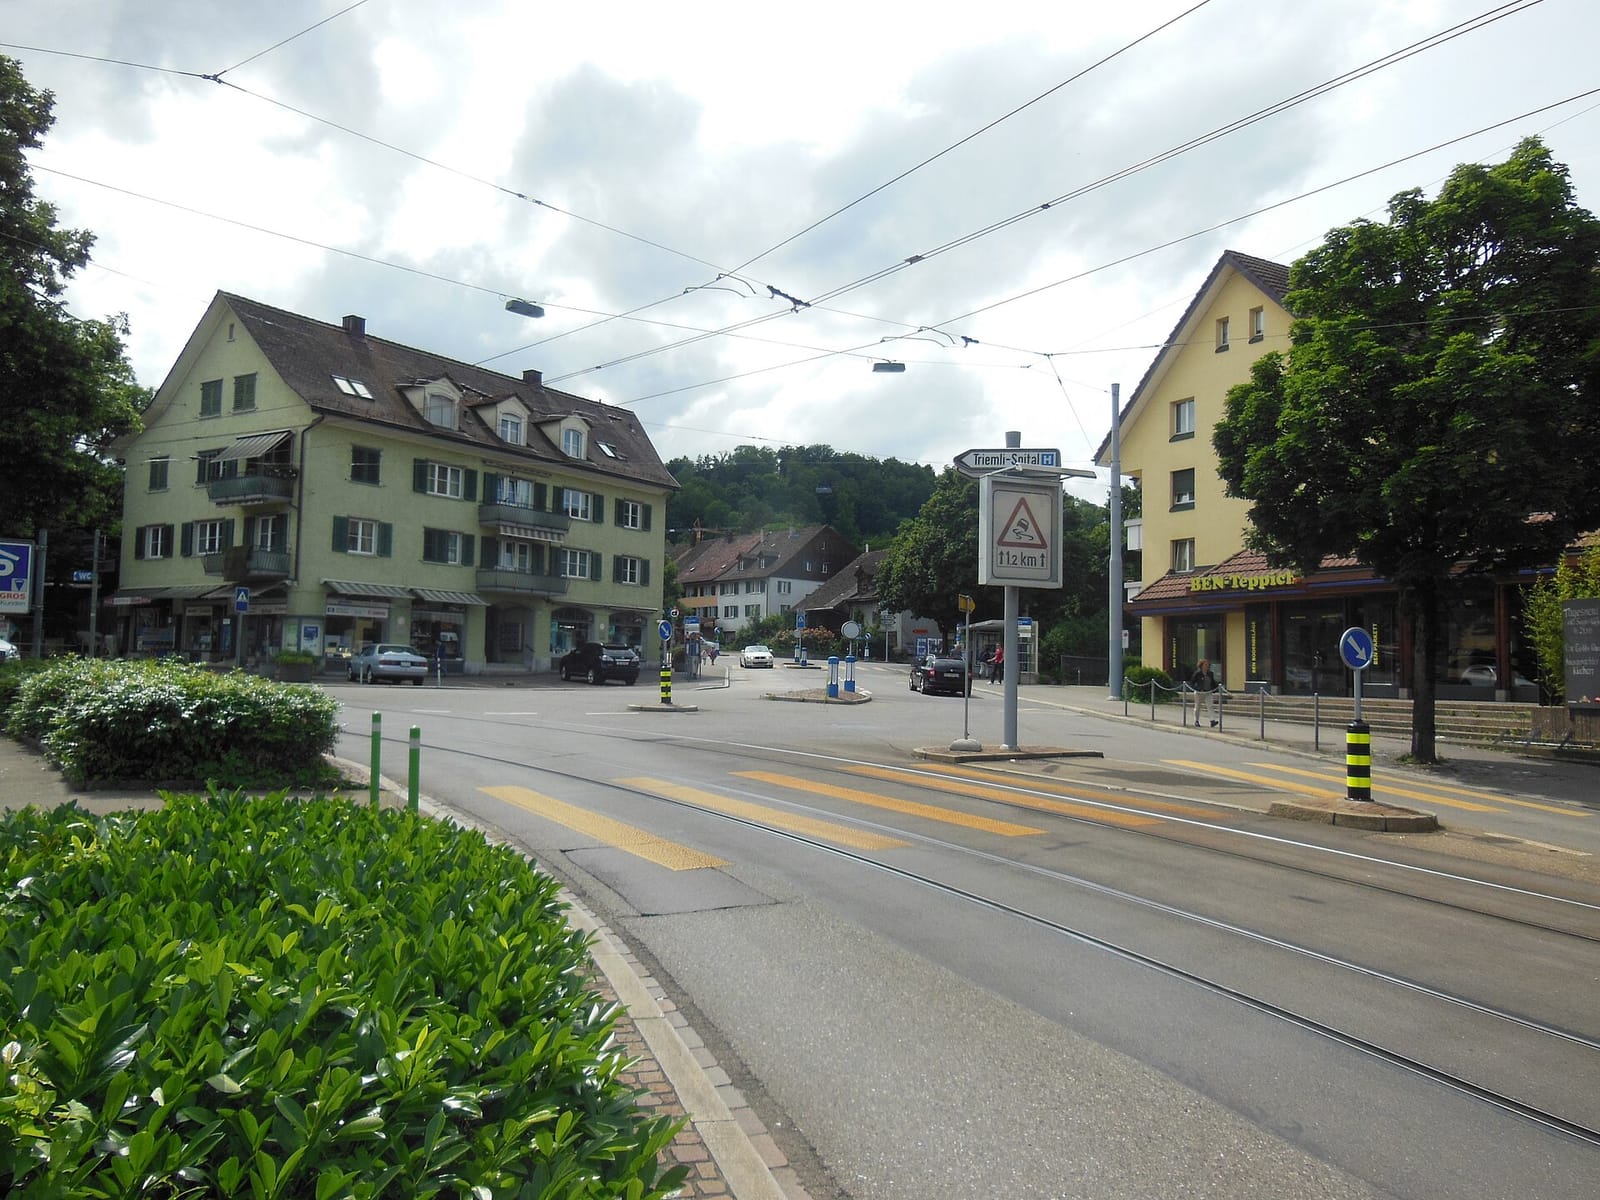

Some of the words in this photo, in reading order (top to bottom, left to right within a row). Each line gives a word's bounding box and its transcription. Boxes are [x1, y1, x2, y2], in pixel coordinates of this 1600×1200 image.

[973, 453, 1040, 465] Triemli-Spital
[1020, 551, 1037, 567] km
[1190, 570, 1295, 591] BEN-Teppich
